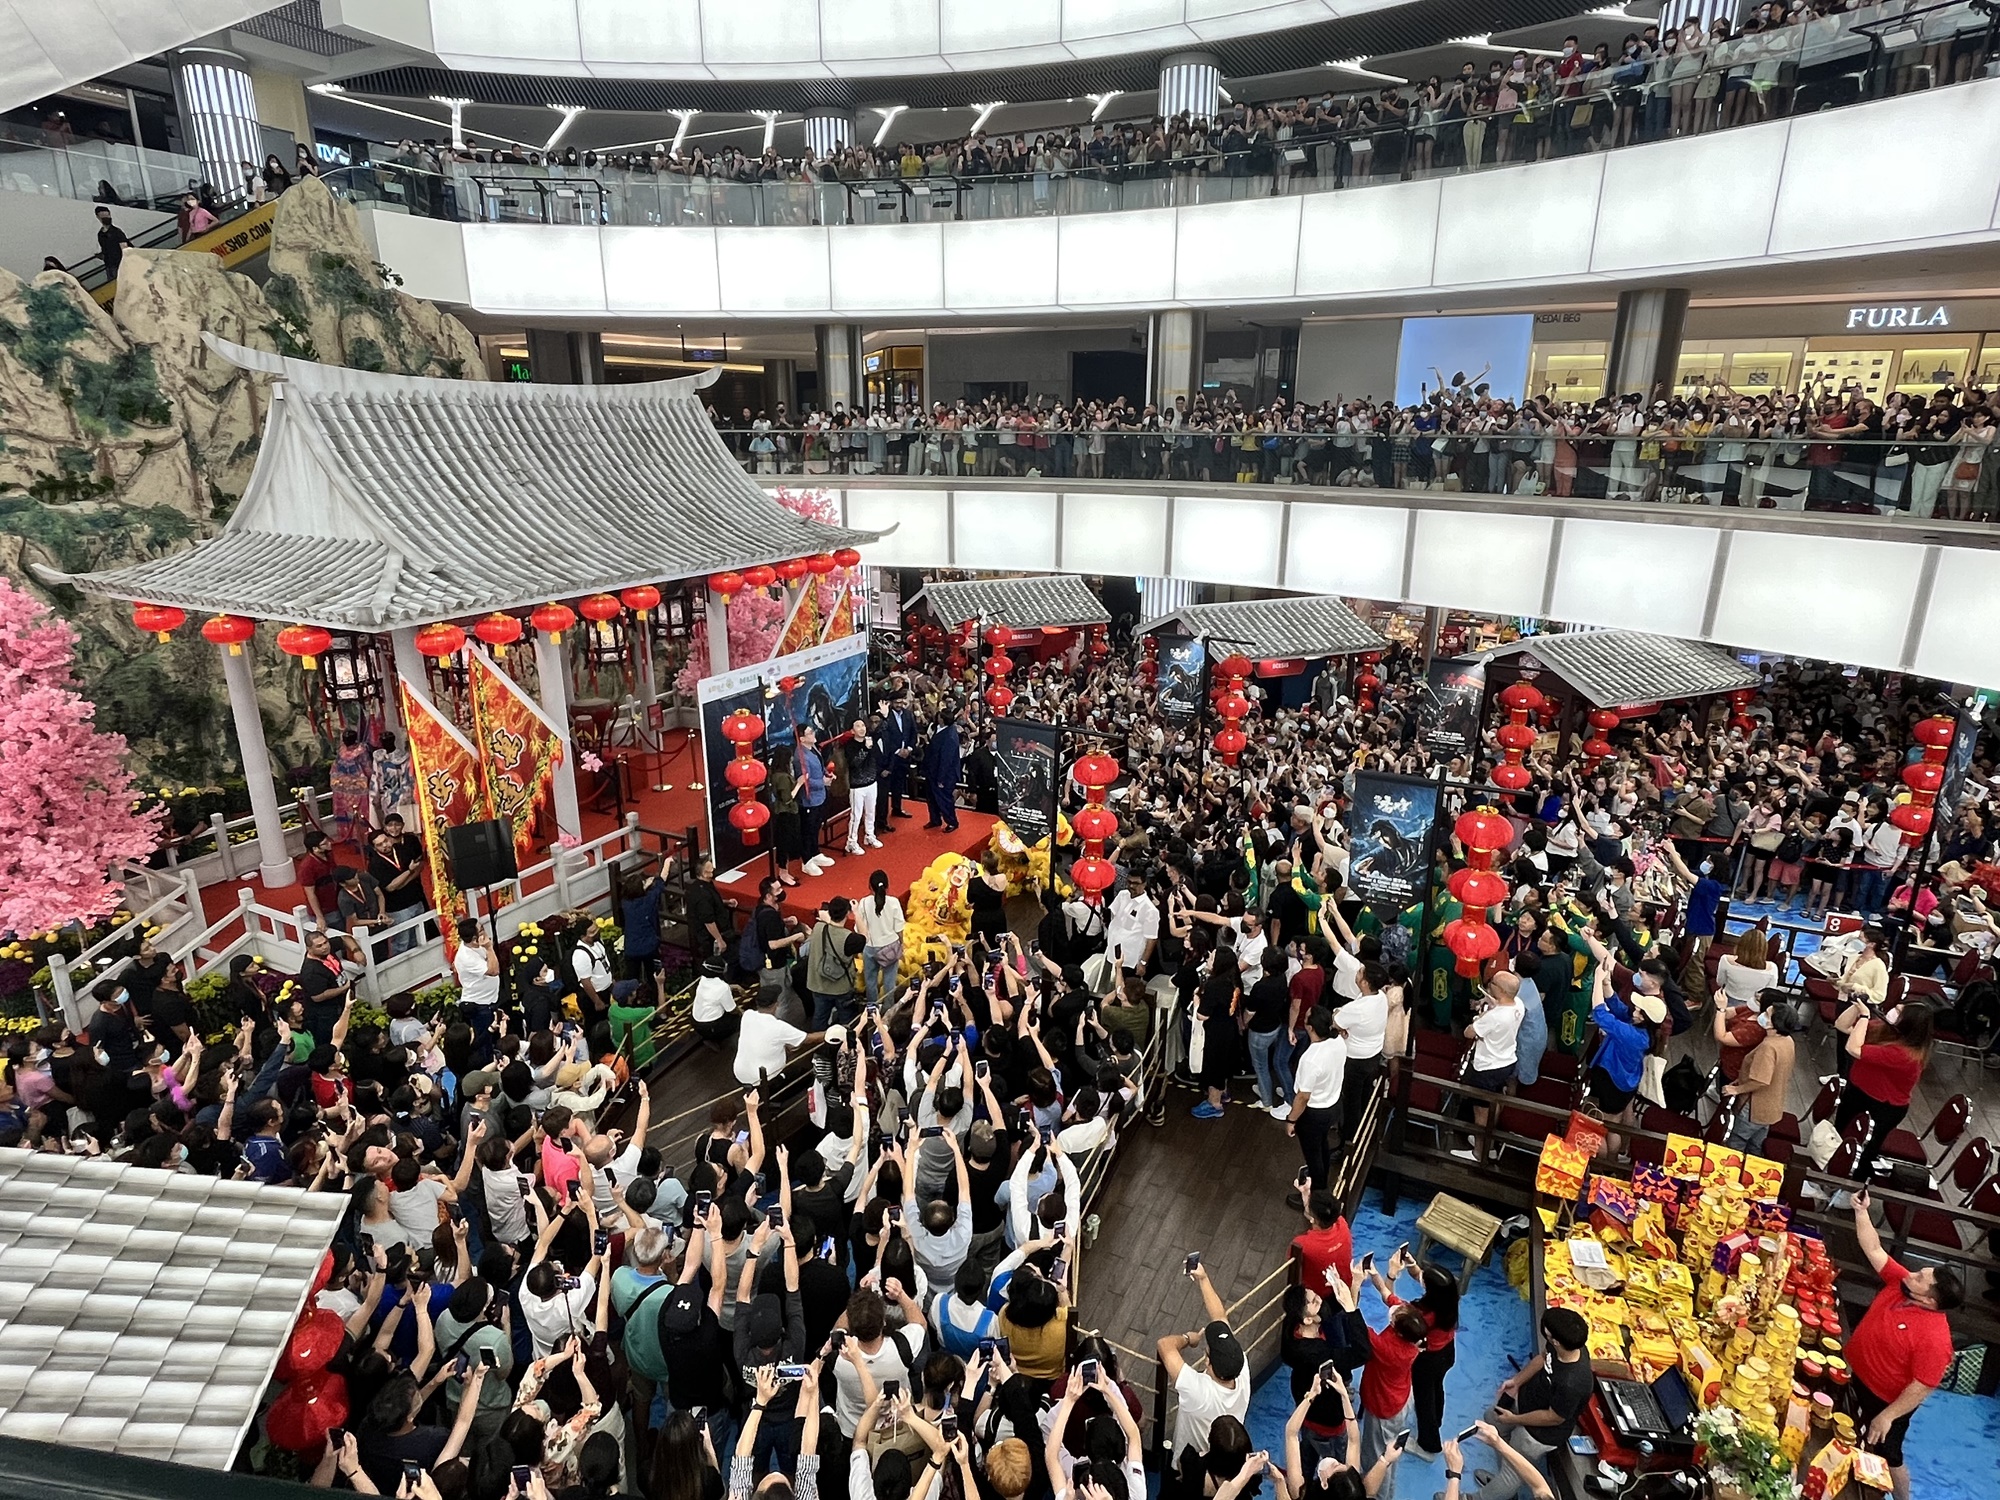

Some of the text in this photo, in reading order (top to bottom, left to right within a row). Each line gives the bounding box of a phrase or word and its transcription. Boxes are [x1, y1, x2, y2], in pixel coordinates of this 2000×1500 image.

[210, 217, 275, 258] ONESHOP.COM
[1536, 313, 1581, 324] KEDAI BEG
[1846, 306, 1949, 328] FURLA
[511, 363, 532, 380] Ma
